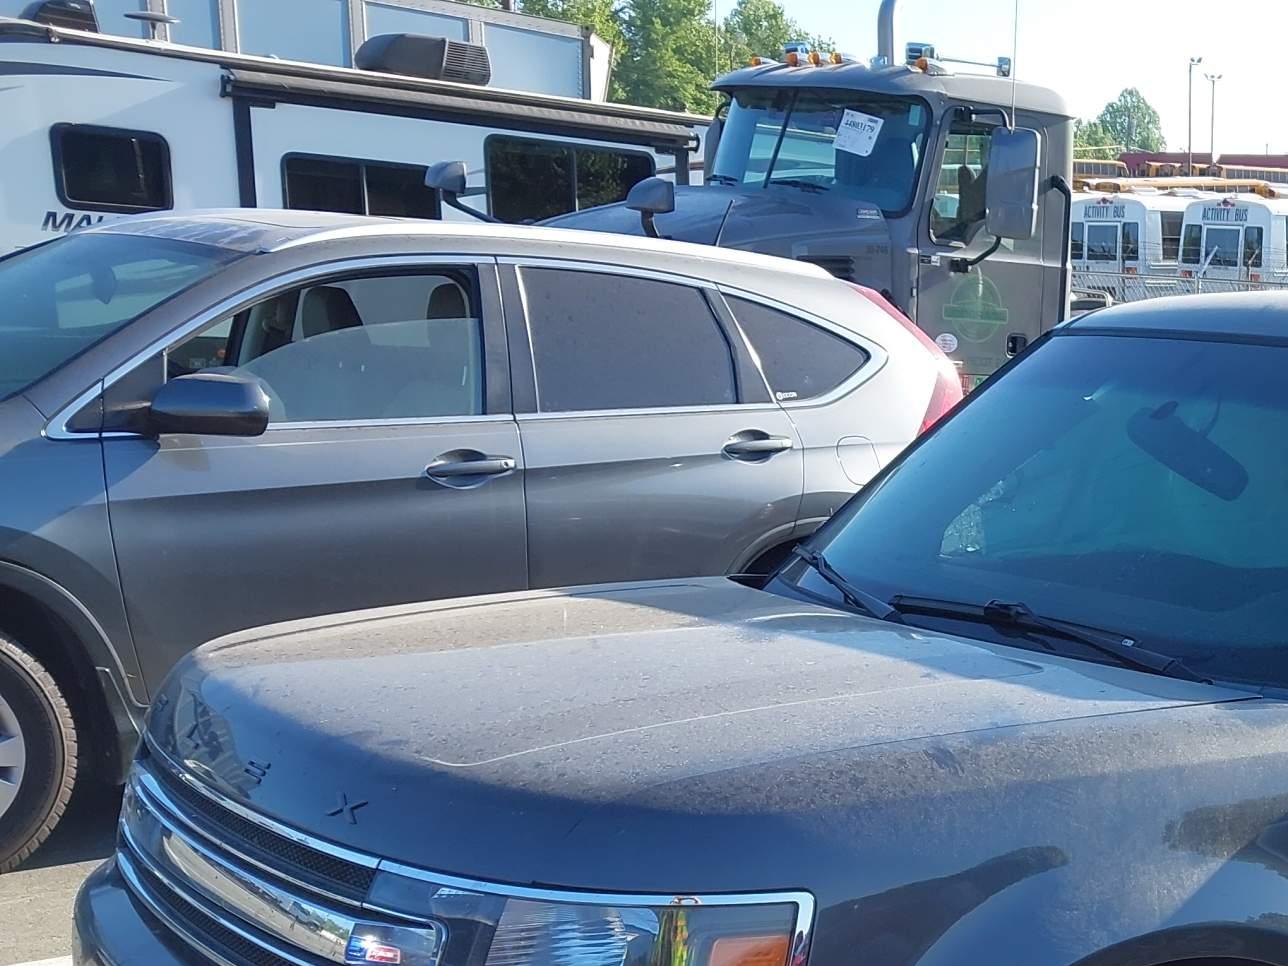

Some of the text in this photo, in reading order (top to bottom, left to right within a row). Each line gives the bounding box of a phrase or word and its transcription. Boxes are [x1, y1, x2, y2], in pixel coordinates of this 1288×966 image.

[1083, 205, 1125, 218] ACTIVITY BUS
[1201, 207, 1248, 222] ACTIVITY BUS
